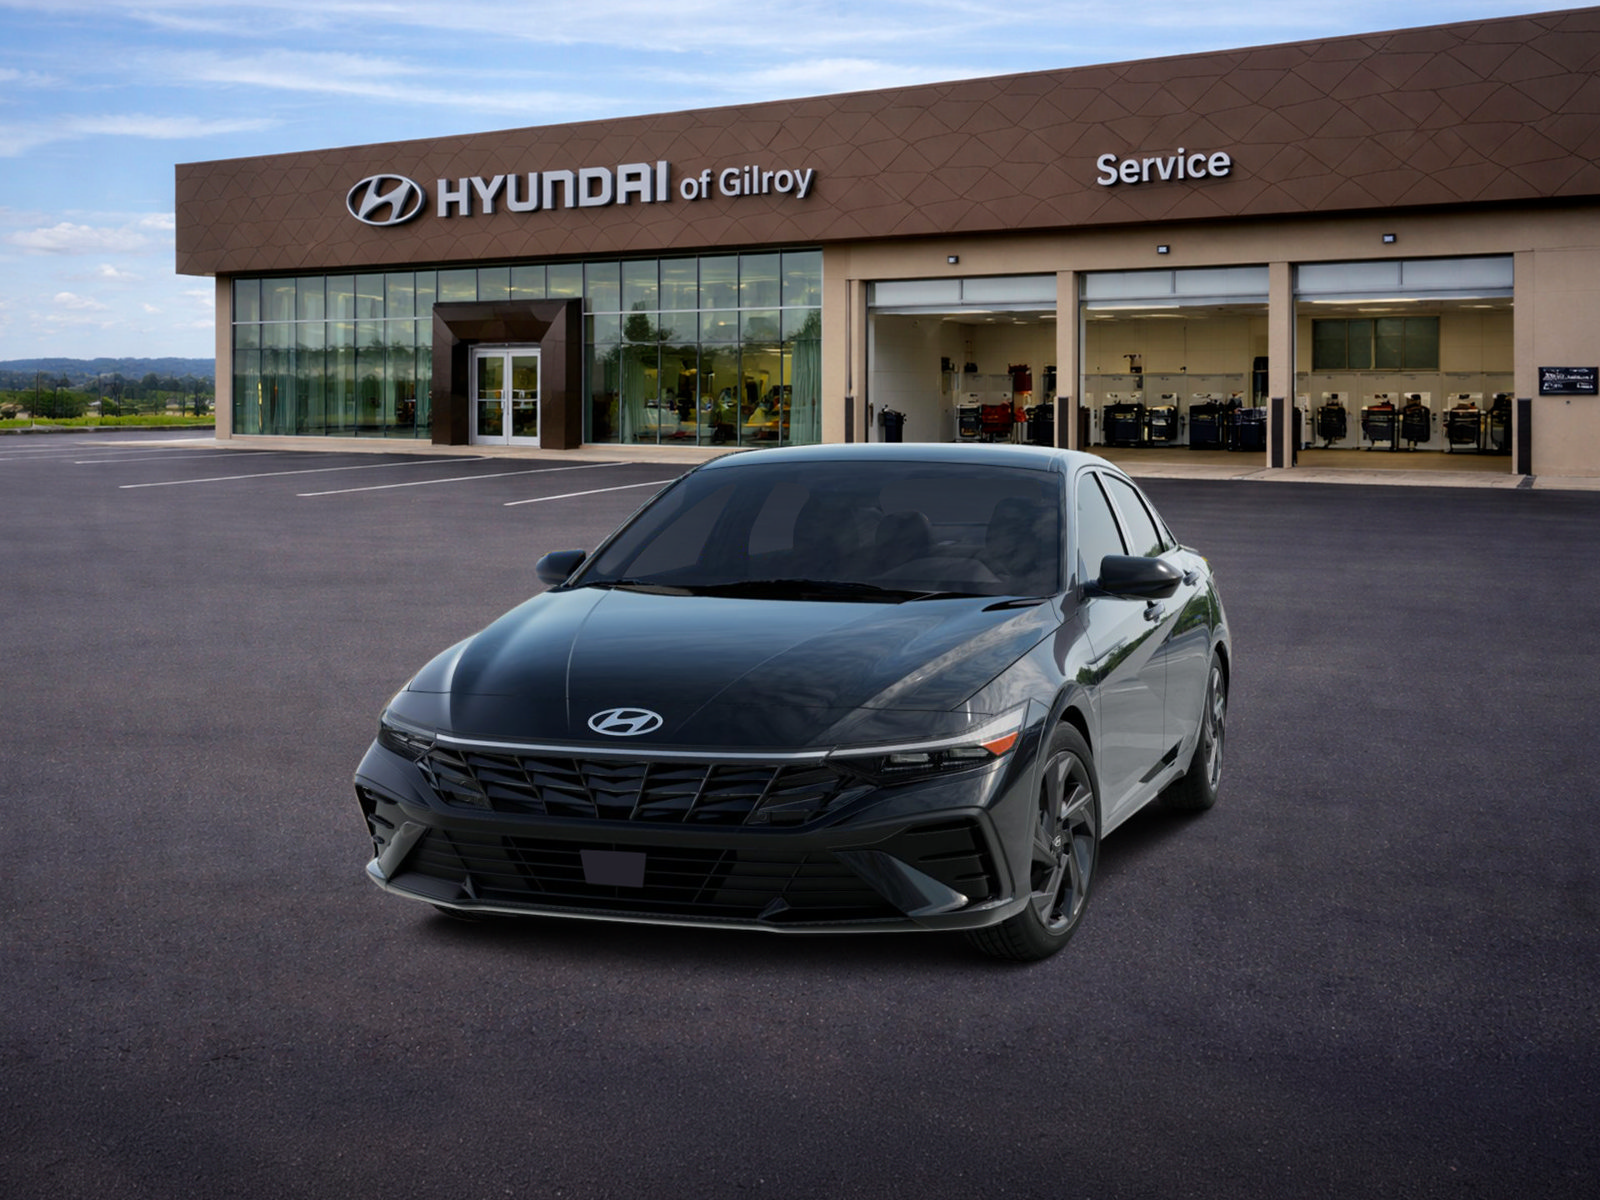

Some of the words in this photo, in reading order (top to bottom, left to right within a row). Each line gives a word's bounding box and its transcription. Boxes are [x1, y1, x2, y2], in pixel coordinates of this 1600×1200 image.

[436, 160, 669, 217] HYUNDAI
[680, 168, 712, 200] of
[719, 165, 814, 199] Gilroy
[1096, 147, 1232, 186] Service
